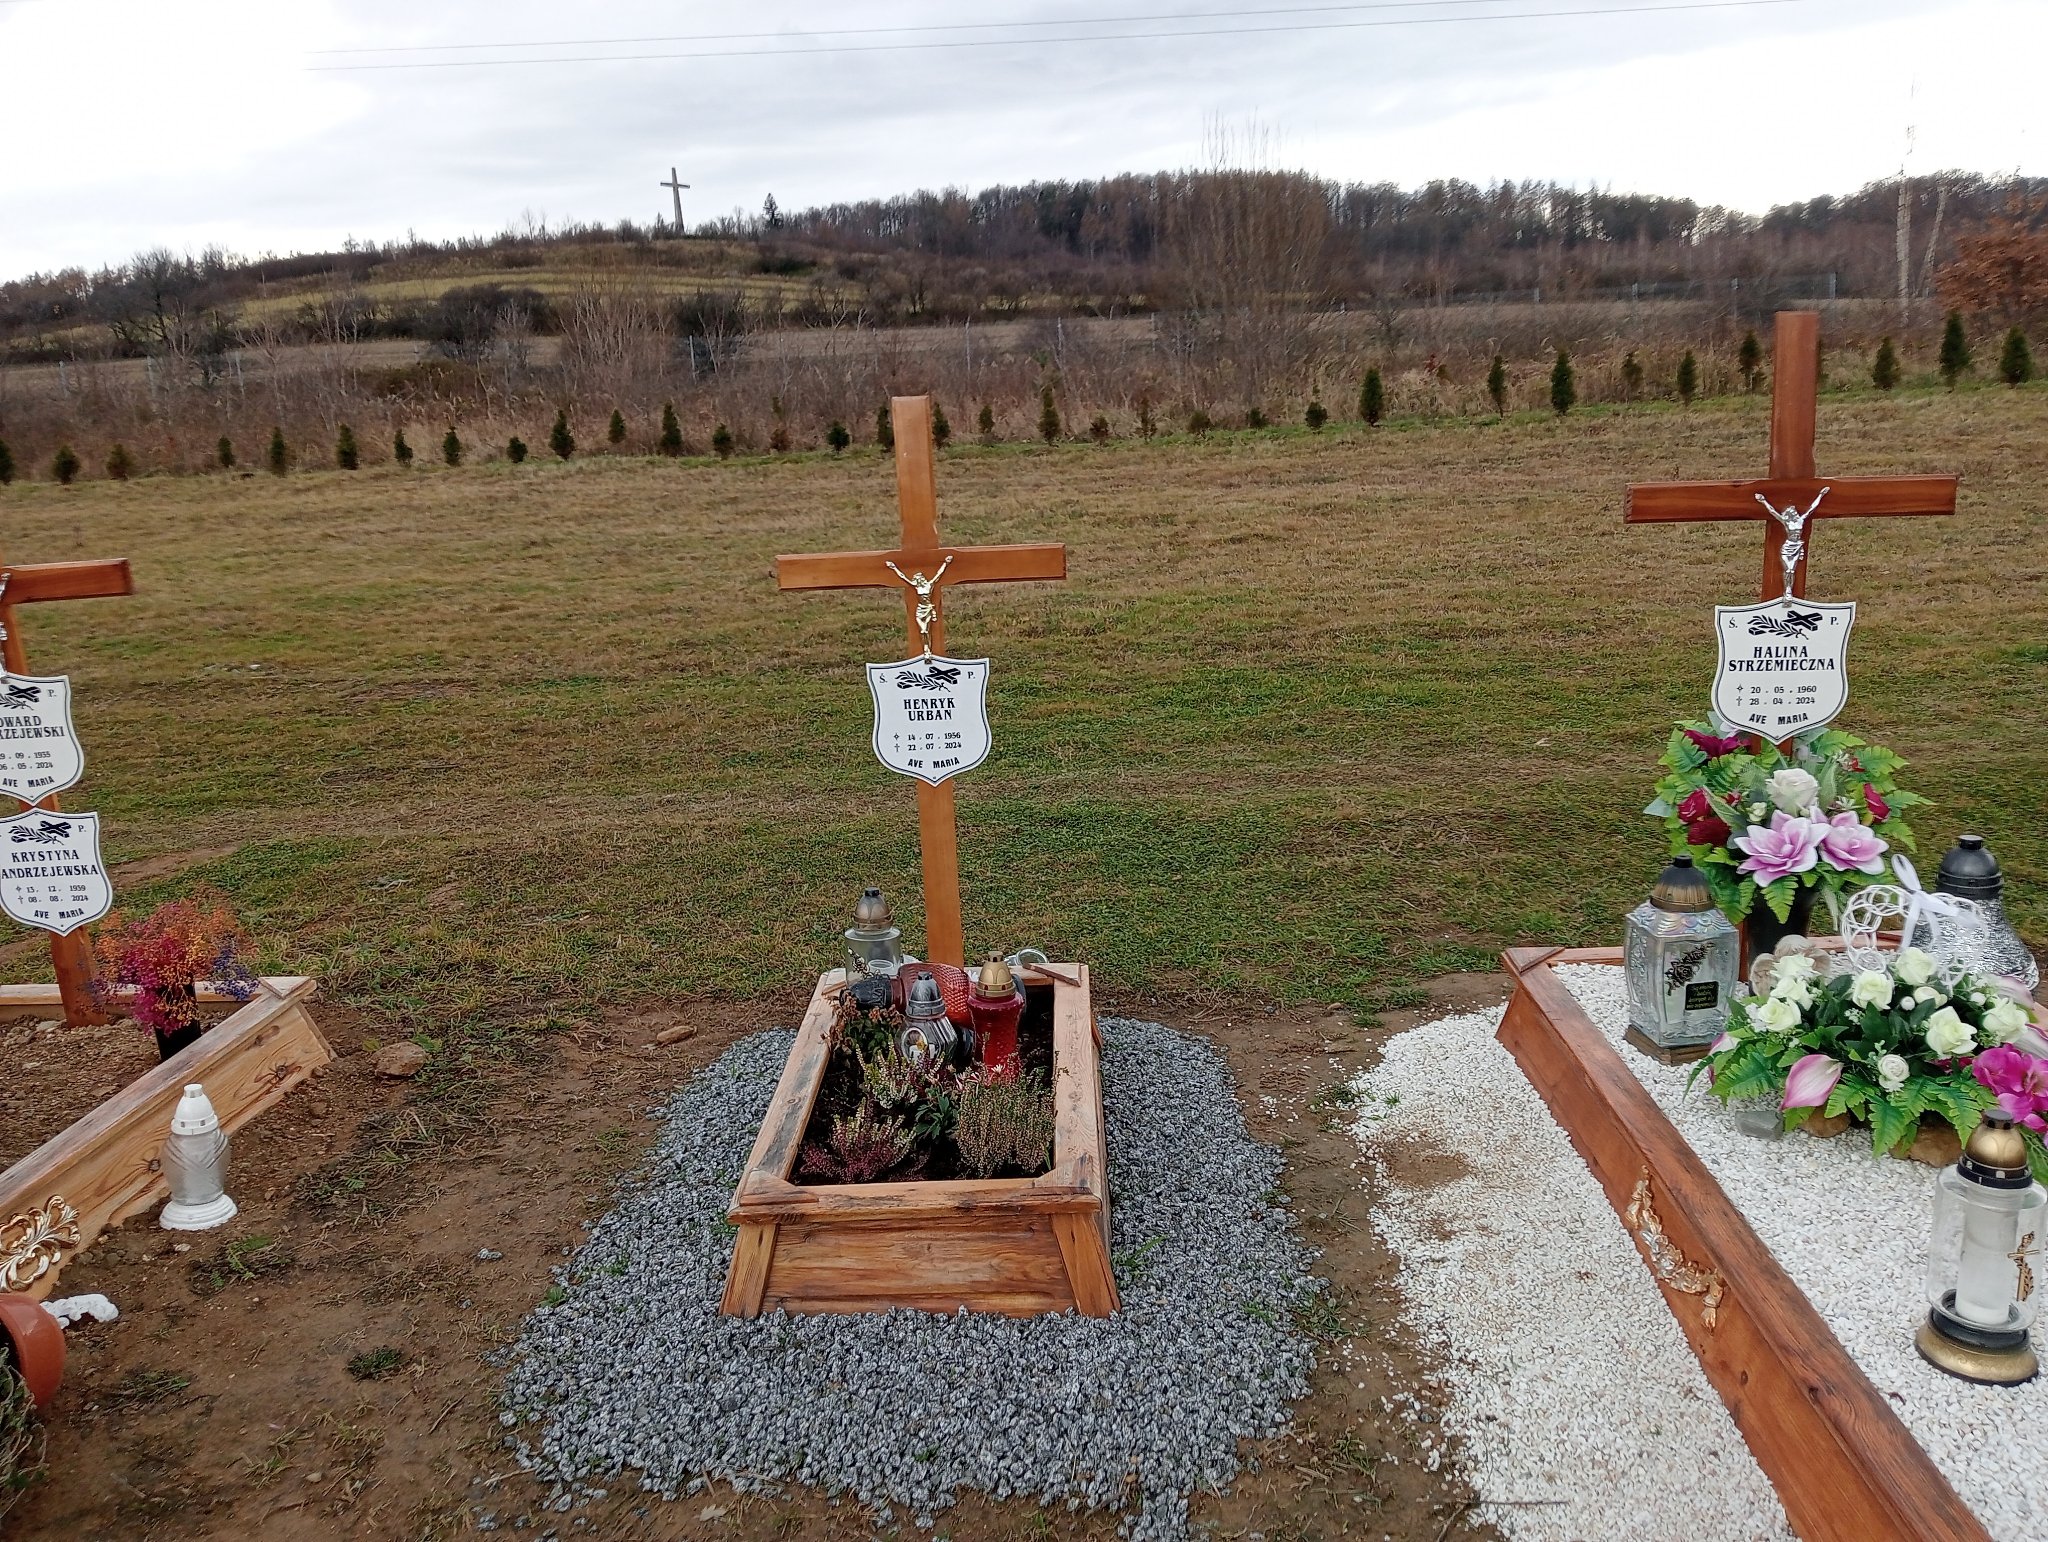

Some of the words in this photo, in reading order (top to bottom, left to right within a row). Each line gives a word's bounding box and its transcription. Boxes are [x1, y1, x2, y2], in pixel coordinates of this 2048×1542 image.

[1729, 617, 1738, 628] Ś.
[1830, 617, 1839, 625] P.
[1754, 646, 1808, 658] HALINA
[1729, 658, 1835, 672] STRZEMIECZNA
[904, 698, 955, 709] HENRYK
[908, 710, 952, 721] URBAN
[1749, 713, 1767, 724] AVE
[1777, 713, 1808, 725] MARIA
[908, 759, 923, 768] AVE
[933, 757, 960, 768] MARIA
[2, 778, 18, 787] AVE
[28, 776, 55, 787] MARIA
[11, 850, 79, 862] KRYSTYNA
[2, 864, 99, 879] ANDRZEJEWSKA
[34, 910, 50, 919] AVE
[59, 908, 85, 919] MARIA
